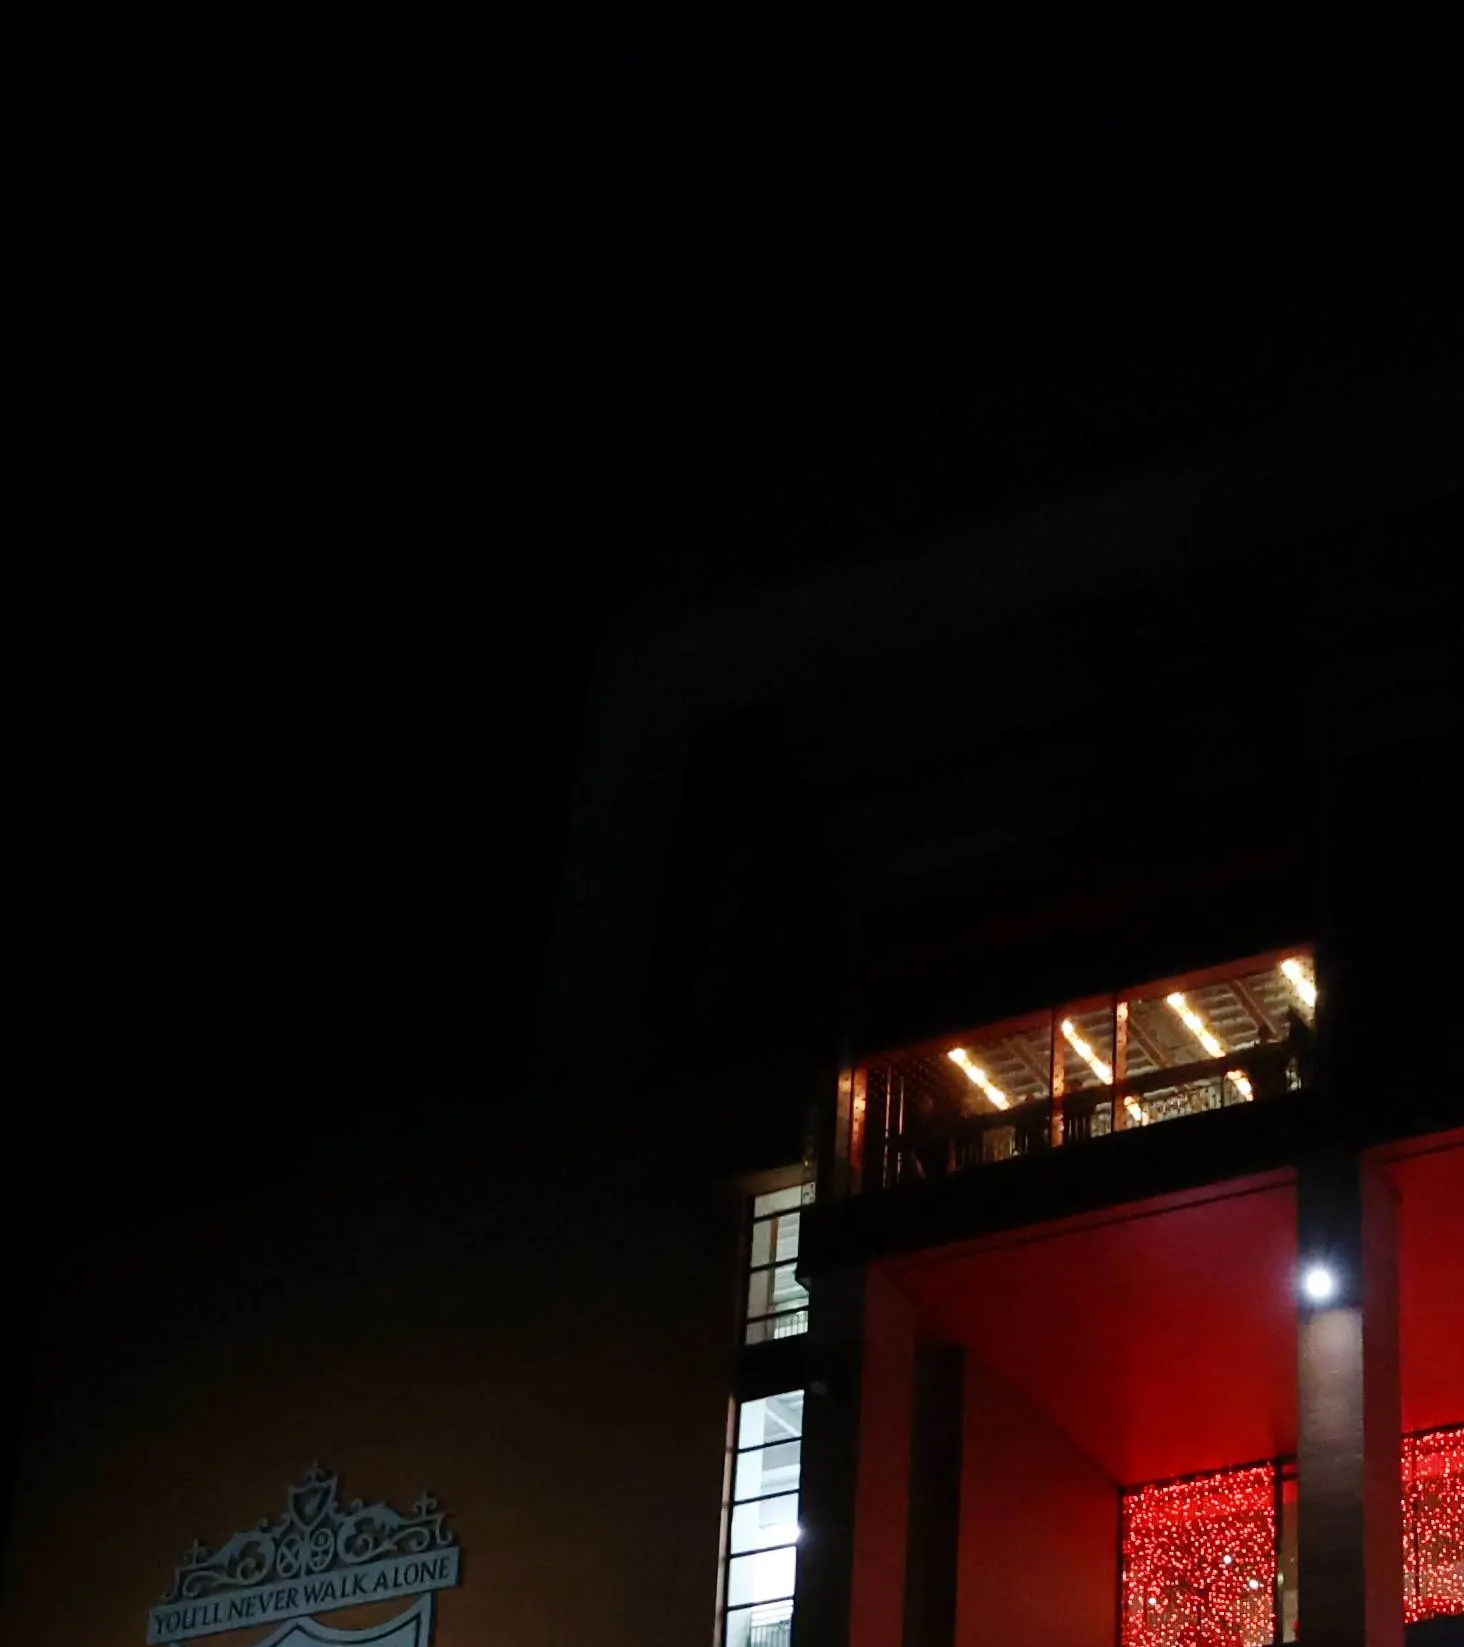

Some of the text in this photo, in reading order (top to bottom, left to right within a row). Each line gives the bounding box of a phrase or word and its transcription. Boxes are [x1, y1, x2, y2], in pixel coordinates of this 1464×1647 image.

[154, 1556, 451, 1635] YOU'LL NEVER WALK ALONE
